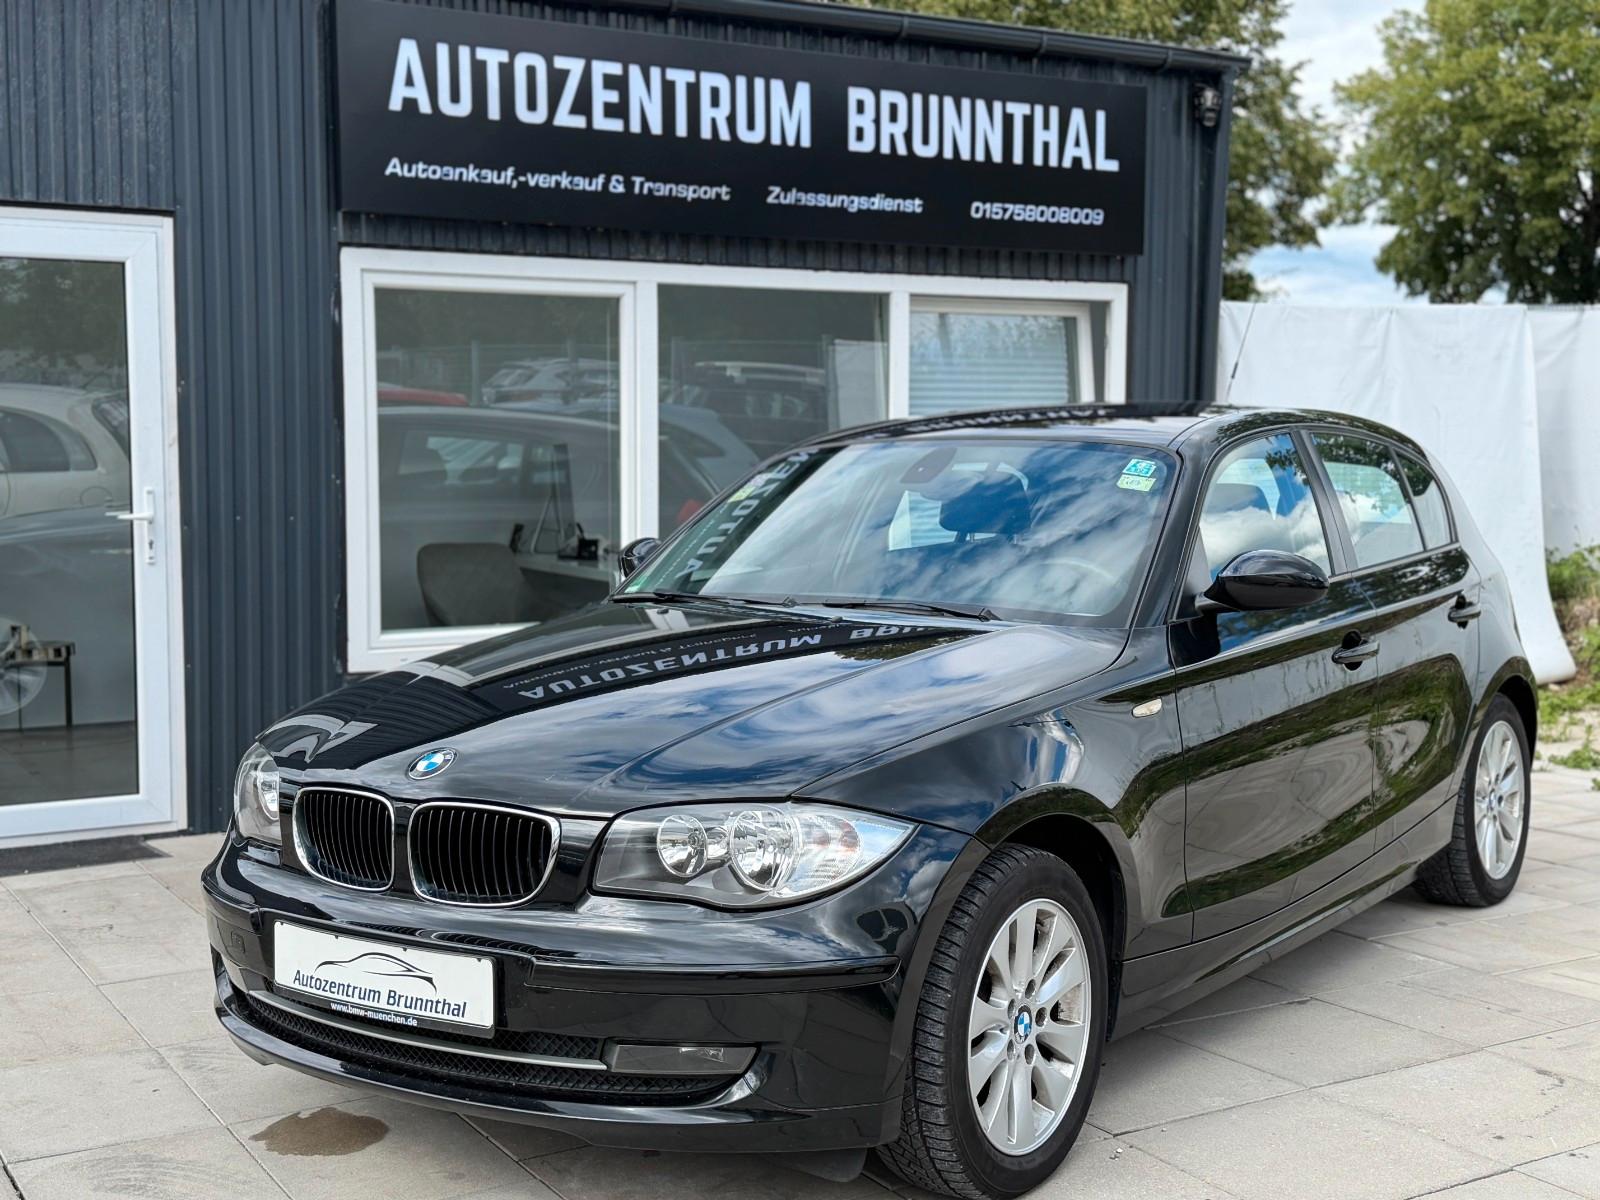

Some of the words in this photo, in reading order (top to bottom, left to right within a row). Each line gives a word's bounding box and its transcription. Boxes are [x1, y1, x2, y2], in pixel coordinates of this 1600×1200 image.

[388, 37, 811, 148] AUTOZENTRUM
[847, 86, 1120, 172] BRUNNTHAL
[608, 175, 626, 193] &
[631, 176, 731, 202] Transport
[766, 186, 923, 213] Zulassungsdienst
[970, 201, 1104, 225] 015758008009
[293, 969, 381, 1003] Autozentrum
[387, 990, 467, 1018] Brunnthal
[330, 1002, 418, 1027] www.bmw-muenchen.de
